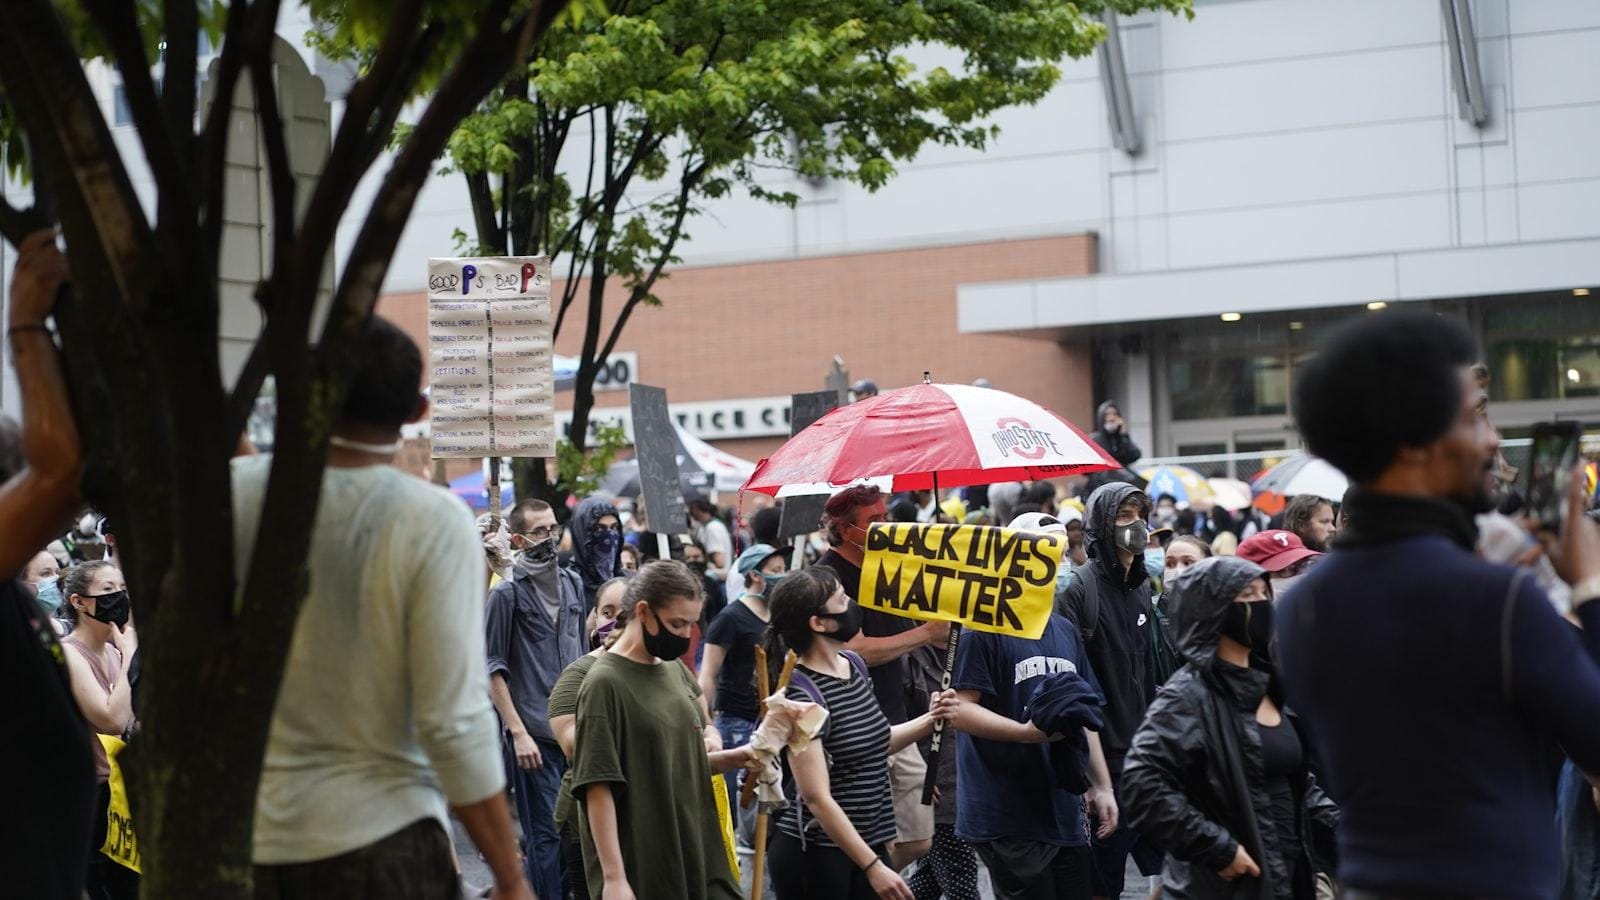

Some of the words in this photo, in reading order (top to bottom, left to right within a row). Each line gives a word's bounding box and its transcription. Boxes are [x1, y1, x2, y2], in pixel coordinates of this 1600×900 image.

[429, 274, 459, 290] GOOD
[495, 274, 518, 287] BAD
[435, 367, 477, 375] PETITIONS
[992, 426, 1019, 457] OHIO
[1012, 426, 1063, 456] STATE
[868, 524, 960, 561] BLACK
[966, 526, 1057, 586] LIVES
[874, 558, 1024, 630] MATTER
[1014, 656, 1046, 685] NEW
[931, 671, 952, 753] KOO
